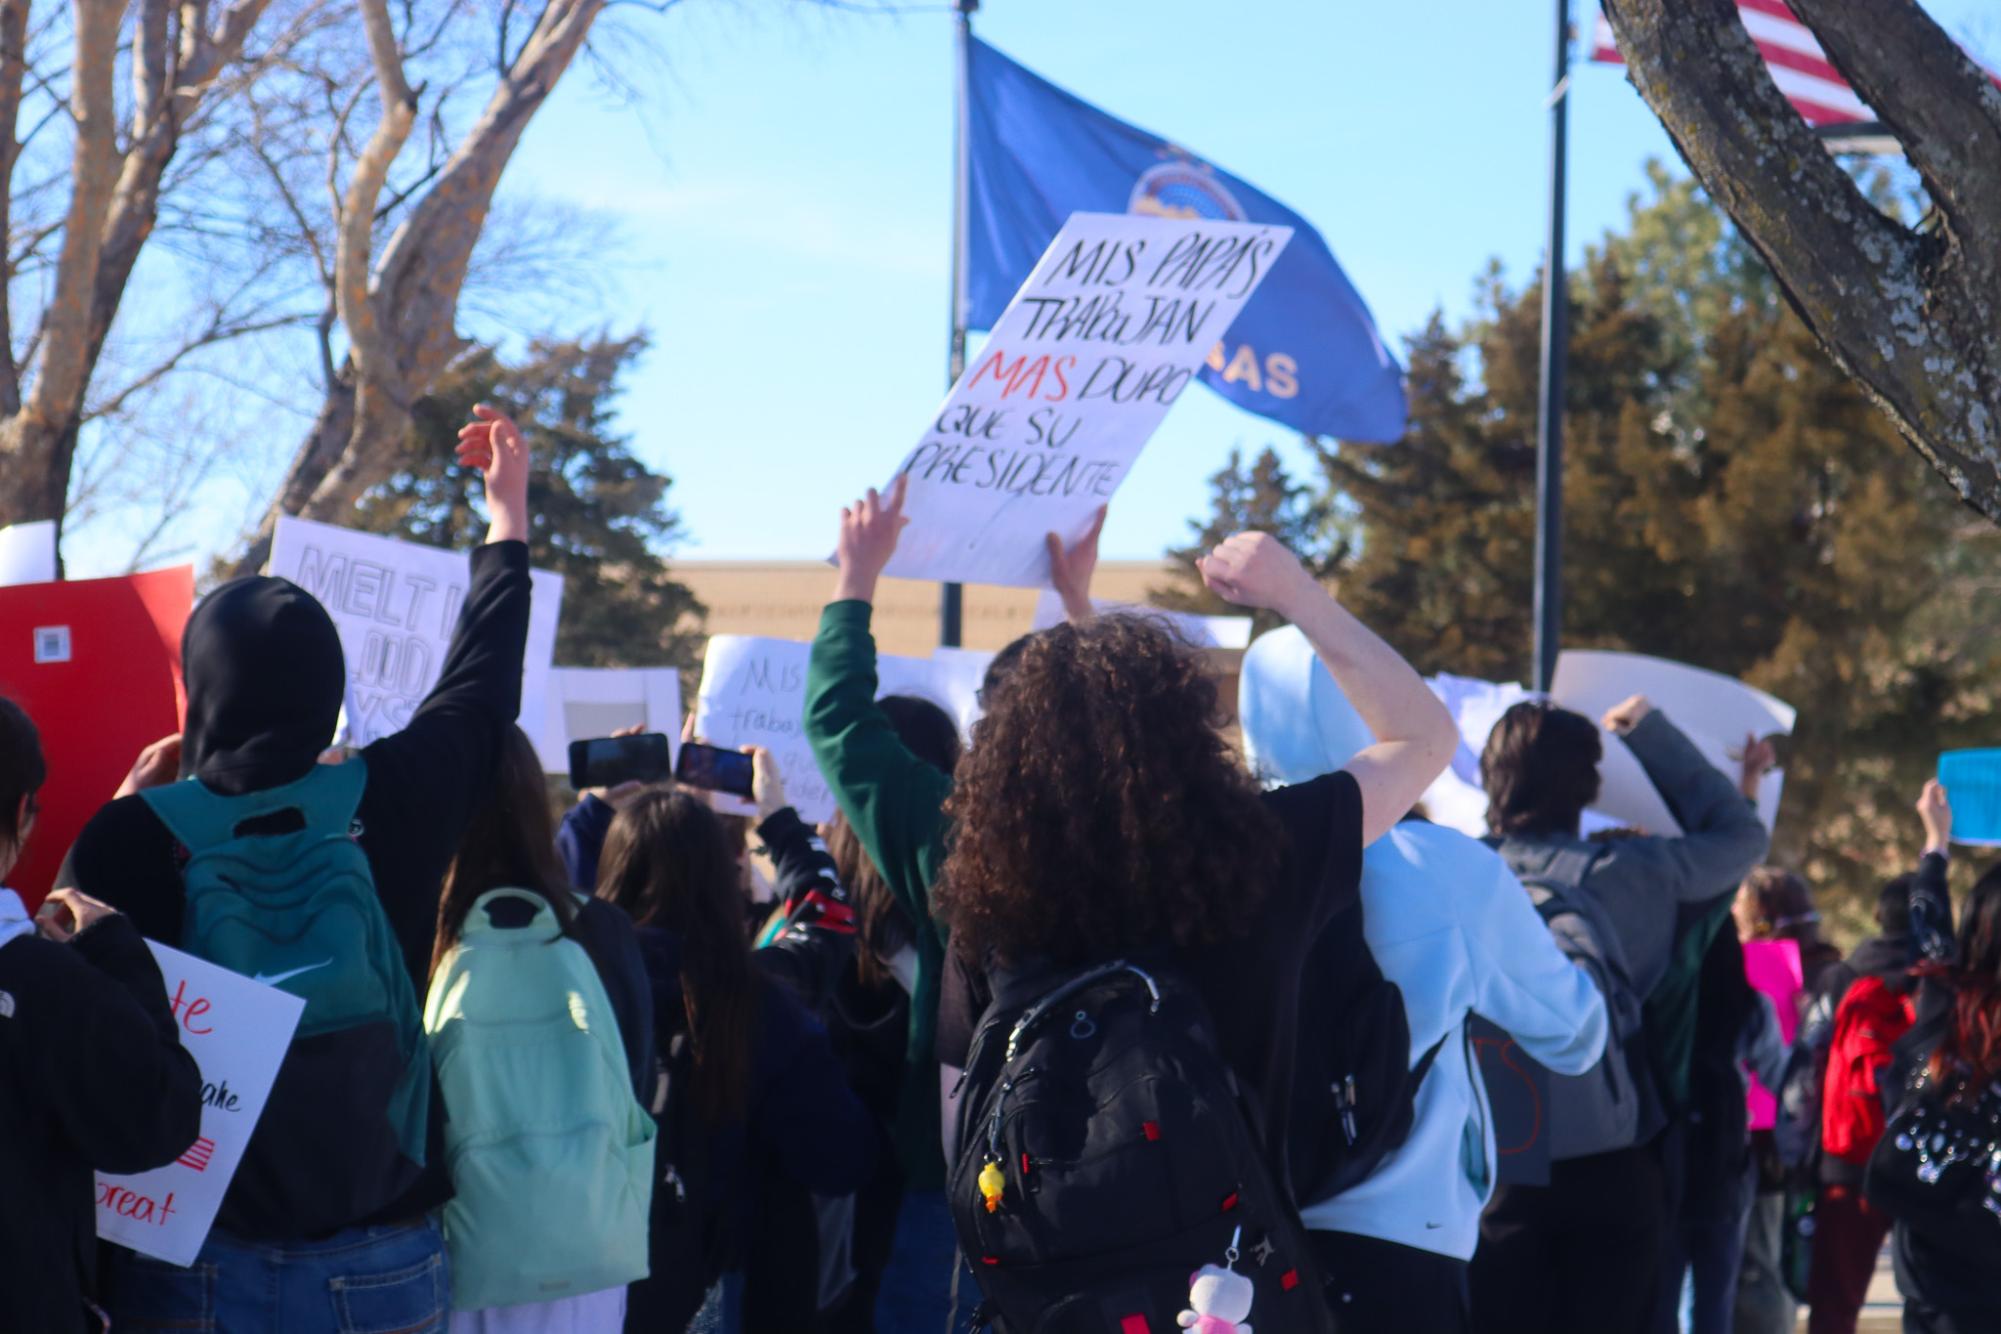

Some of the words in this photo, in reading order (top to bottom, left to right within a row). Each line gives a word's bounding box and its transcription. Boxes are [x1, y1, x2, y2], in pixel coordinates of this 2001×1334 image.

[1043, 239, 1146, 287] MIS
[968, 349, 1076, 401] MAS
[936, 404, 1015, 440] QUE
[1024, 406, 1083, 449] SU
[904, 441, 1121, 498] PRESIDENTE
[296, 543, 437, 632] MELT
